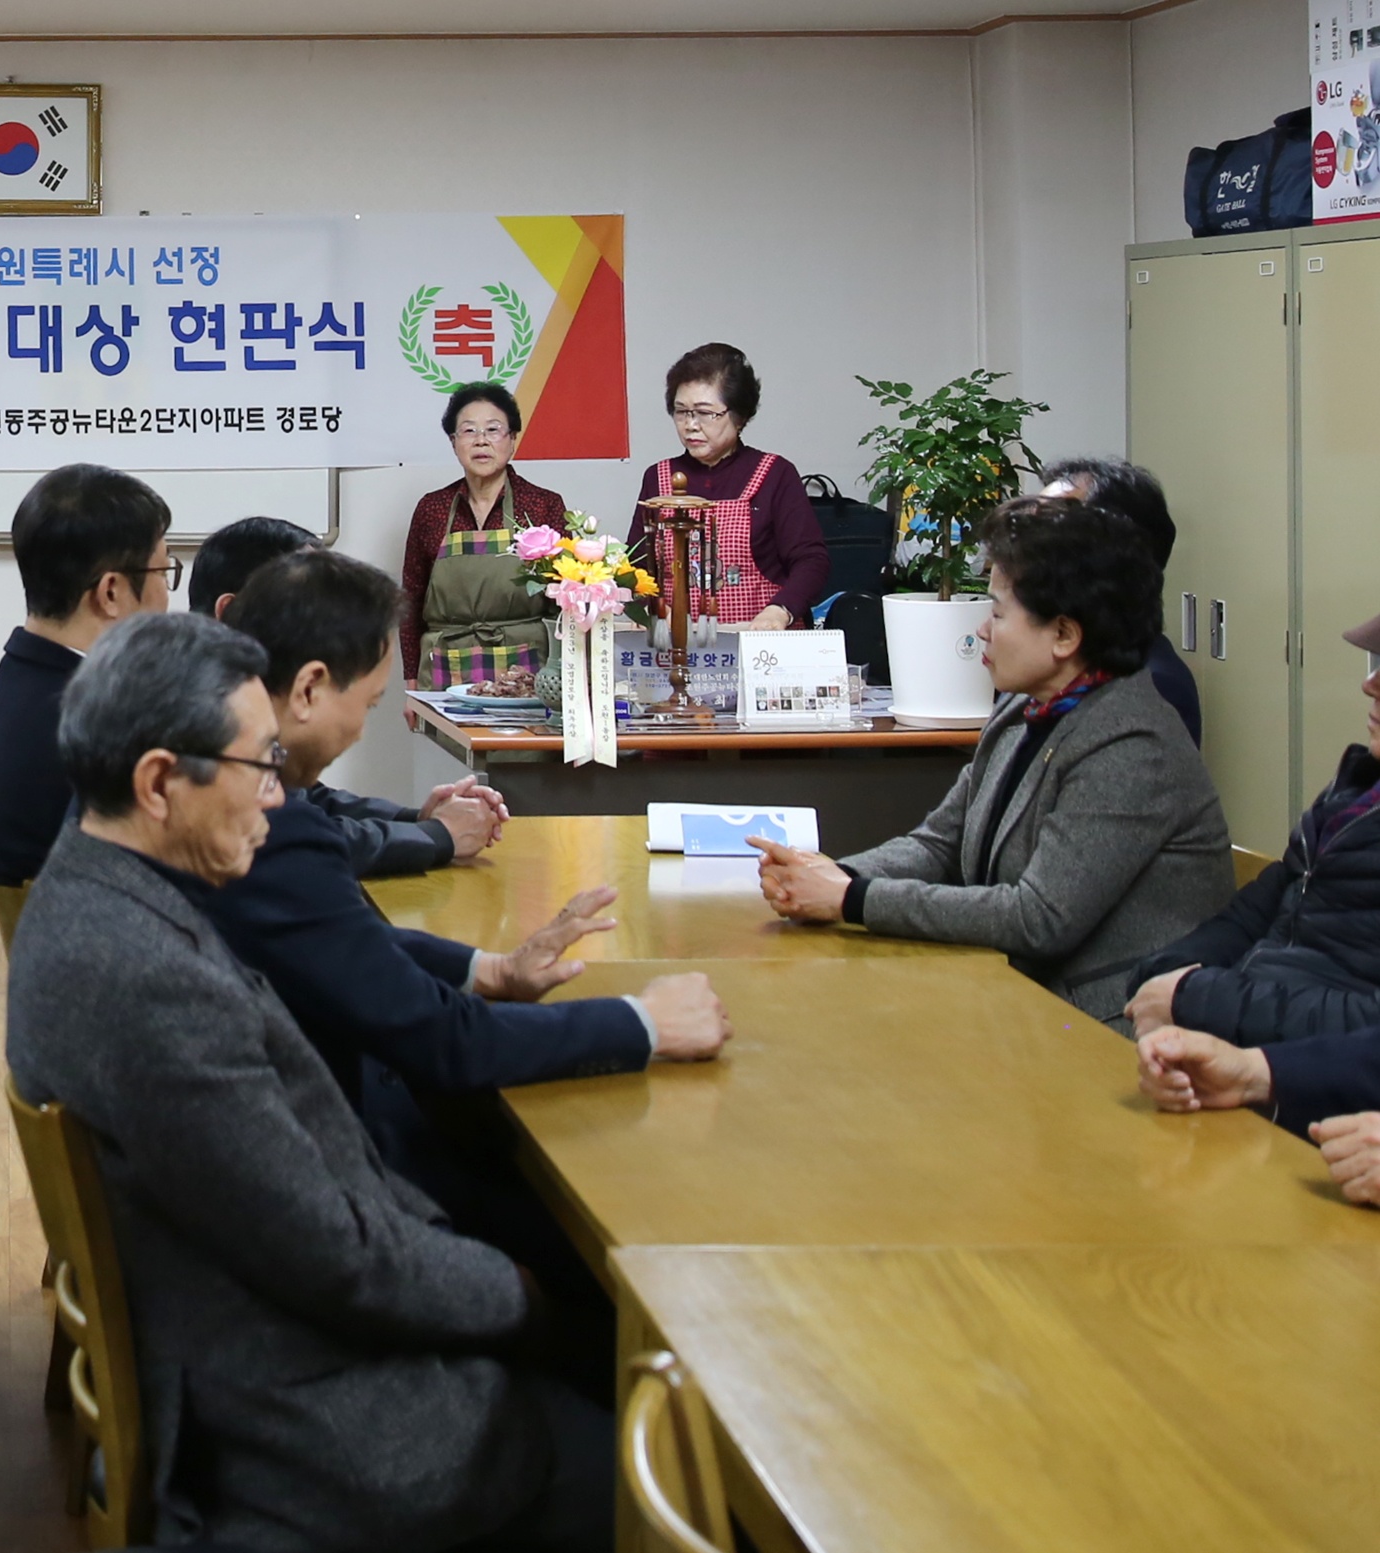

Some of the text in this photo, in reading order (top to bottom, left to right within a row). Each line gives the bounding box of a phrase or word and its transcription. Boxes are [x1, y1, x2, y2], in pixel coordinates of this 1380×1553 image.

[1330, 81, 1342, 98] LG
[1339, 195, 1367, 208] CYKING
[154, 247, 220, 287] 선정
[8, 305, 140, 376] 대상
[169, 301, 366, 371] 현판식
[434, 305, 495, 367] 축
[277, 407, 343, 434] 경로당
